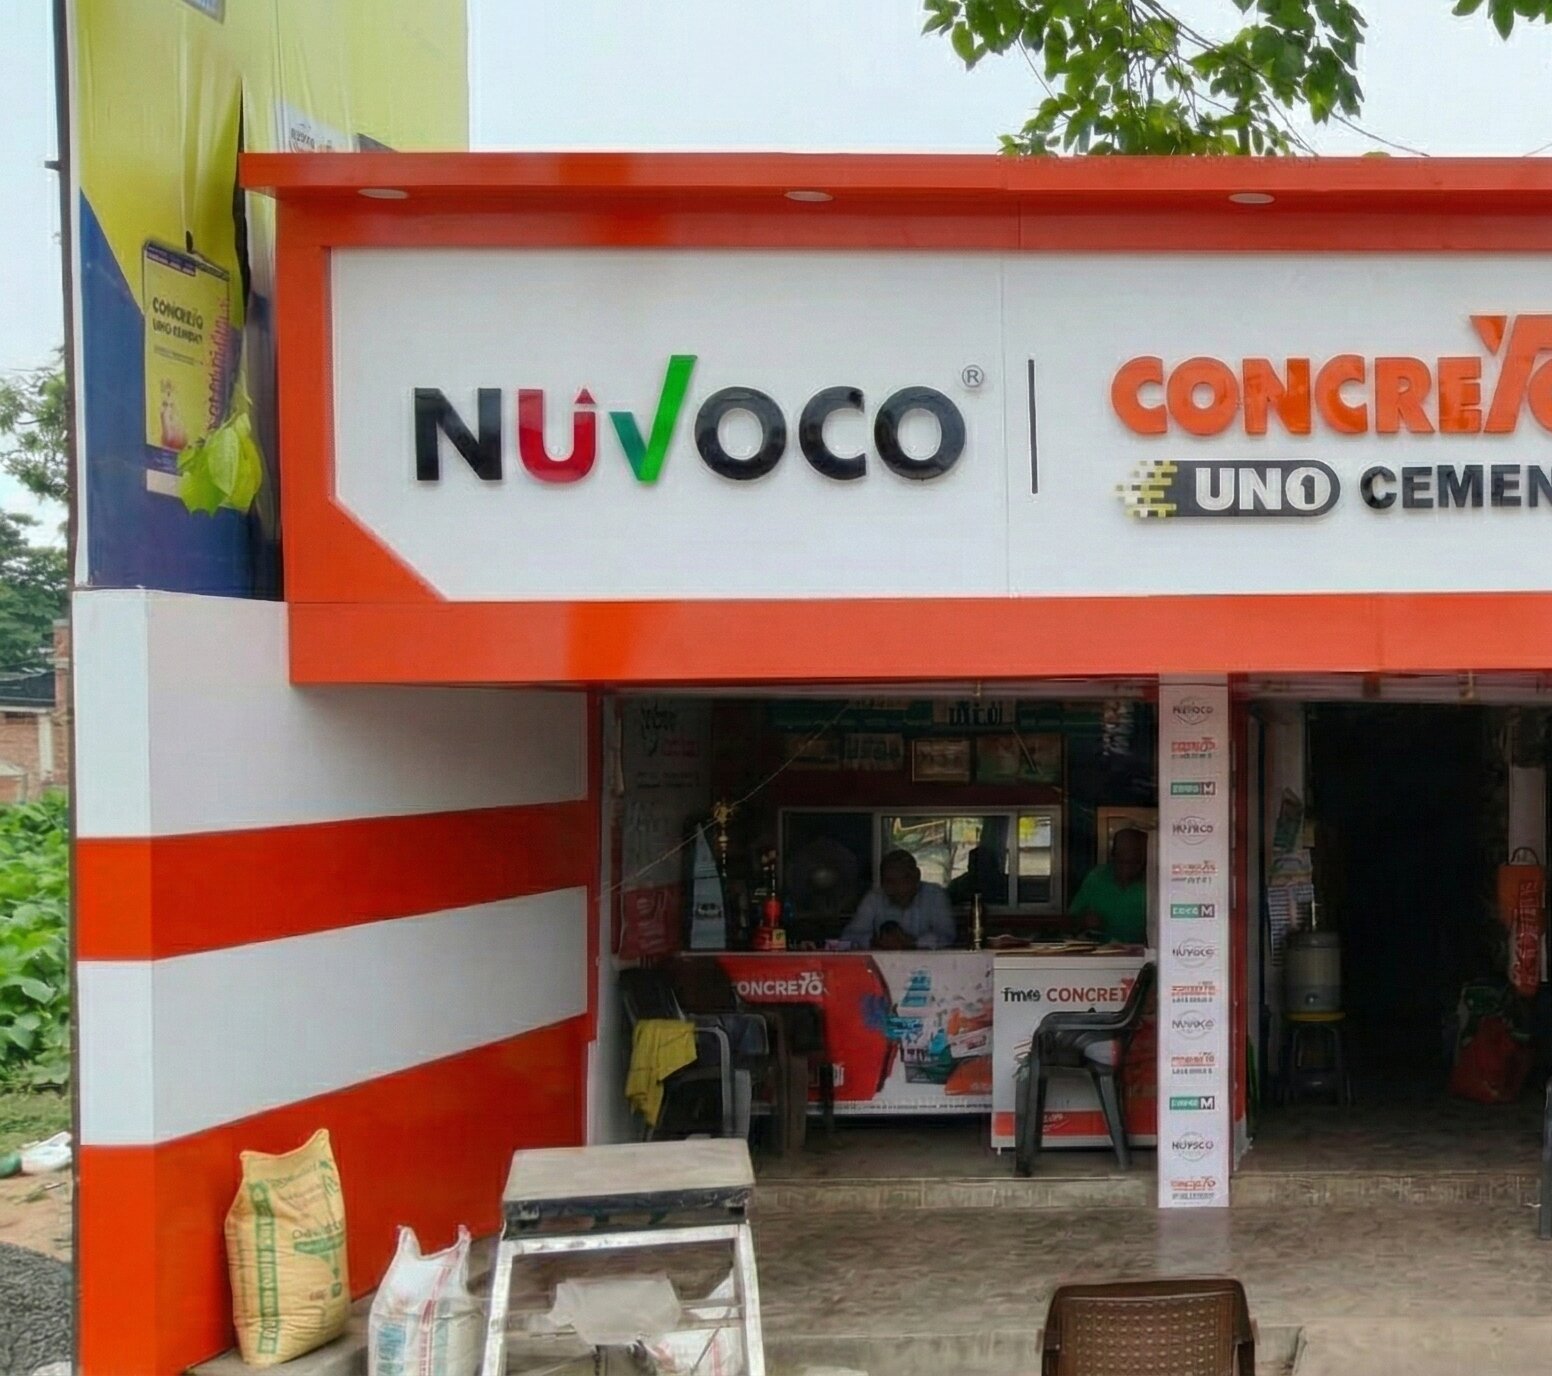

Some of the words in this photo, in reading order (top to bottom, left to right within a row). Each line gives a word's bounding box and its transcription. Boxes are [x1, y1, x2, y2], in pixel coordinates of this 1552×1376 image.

[413, 354, 967, 484] NUVOCO
[733, 971, 824, 996] ONCRETO
[1046, 978, 1135, 1003] CONCRET
